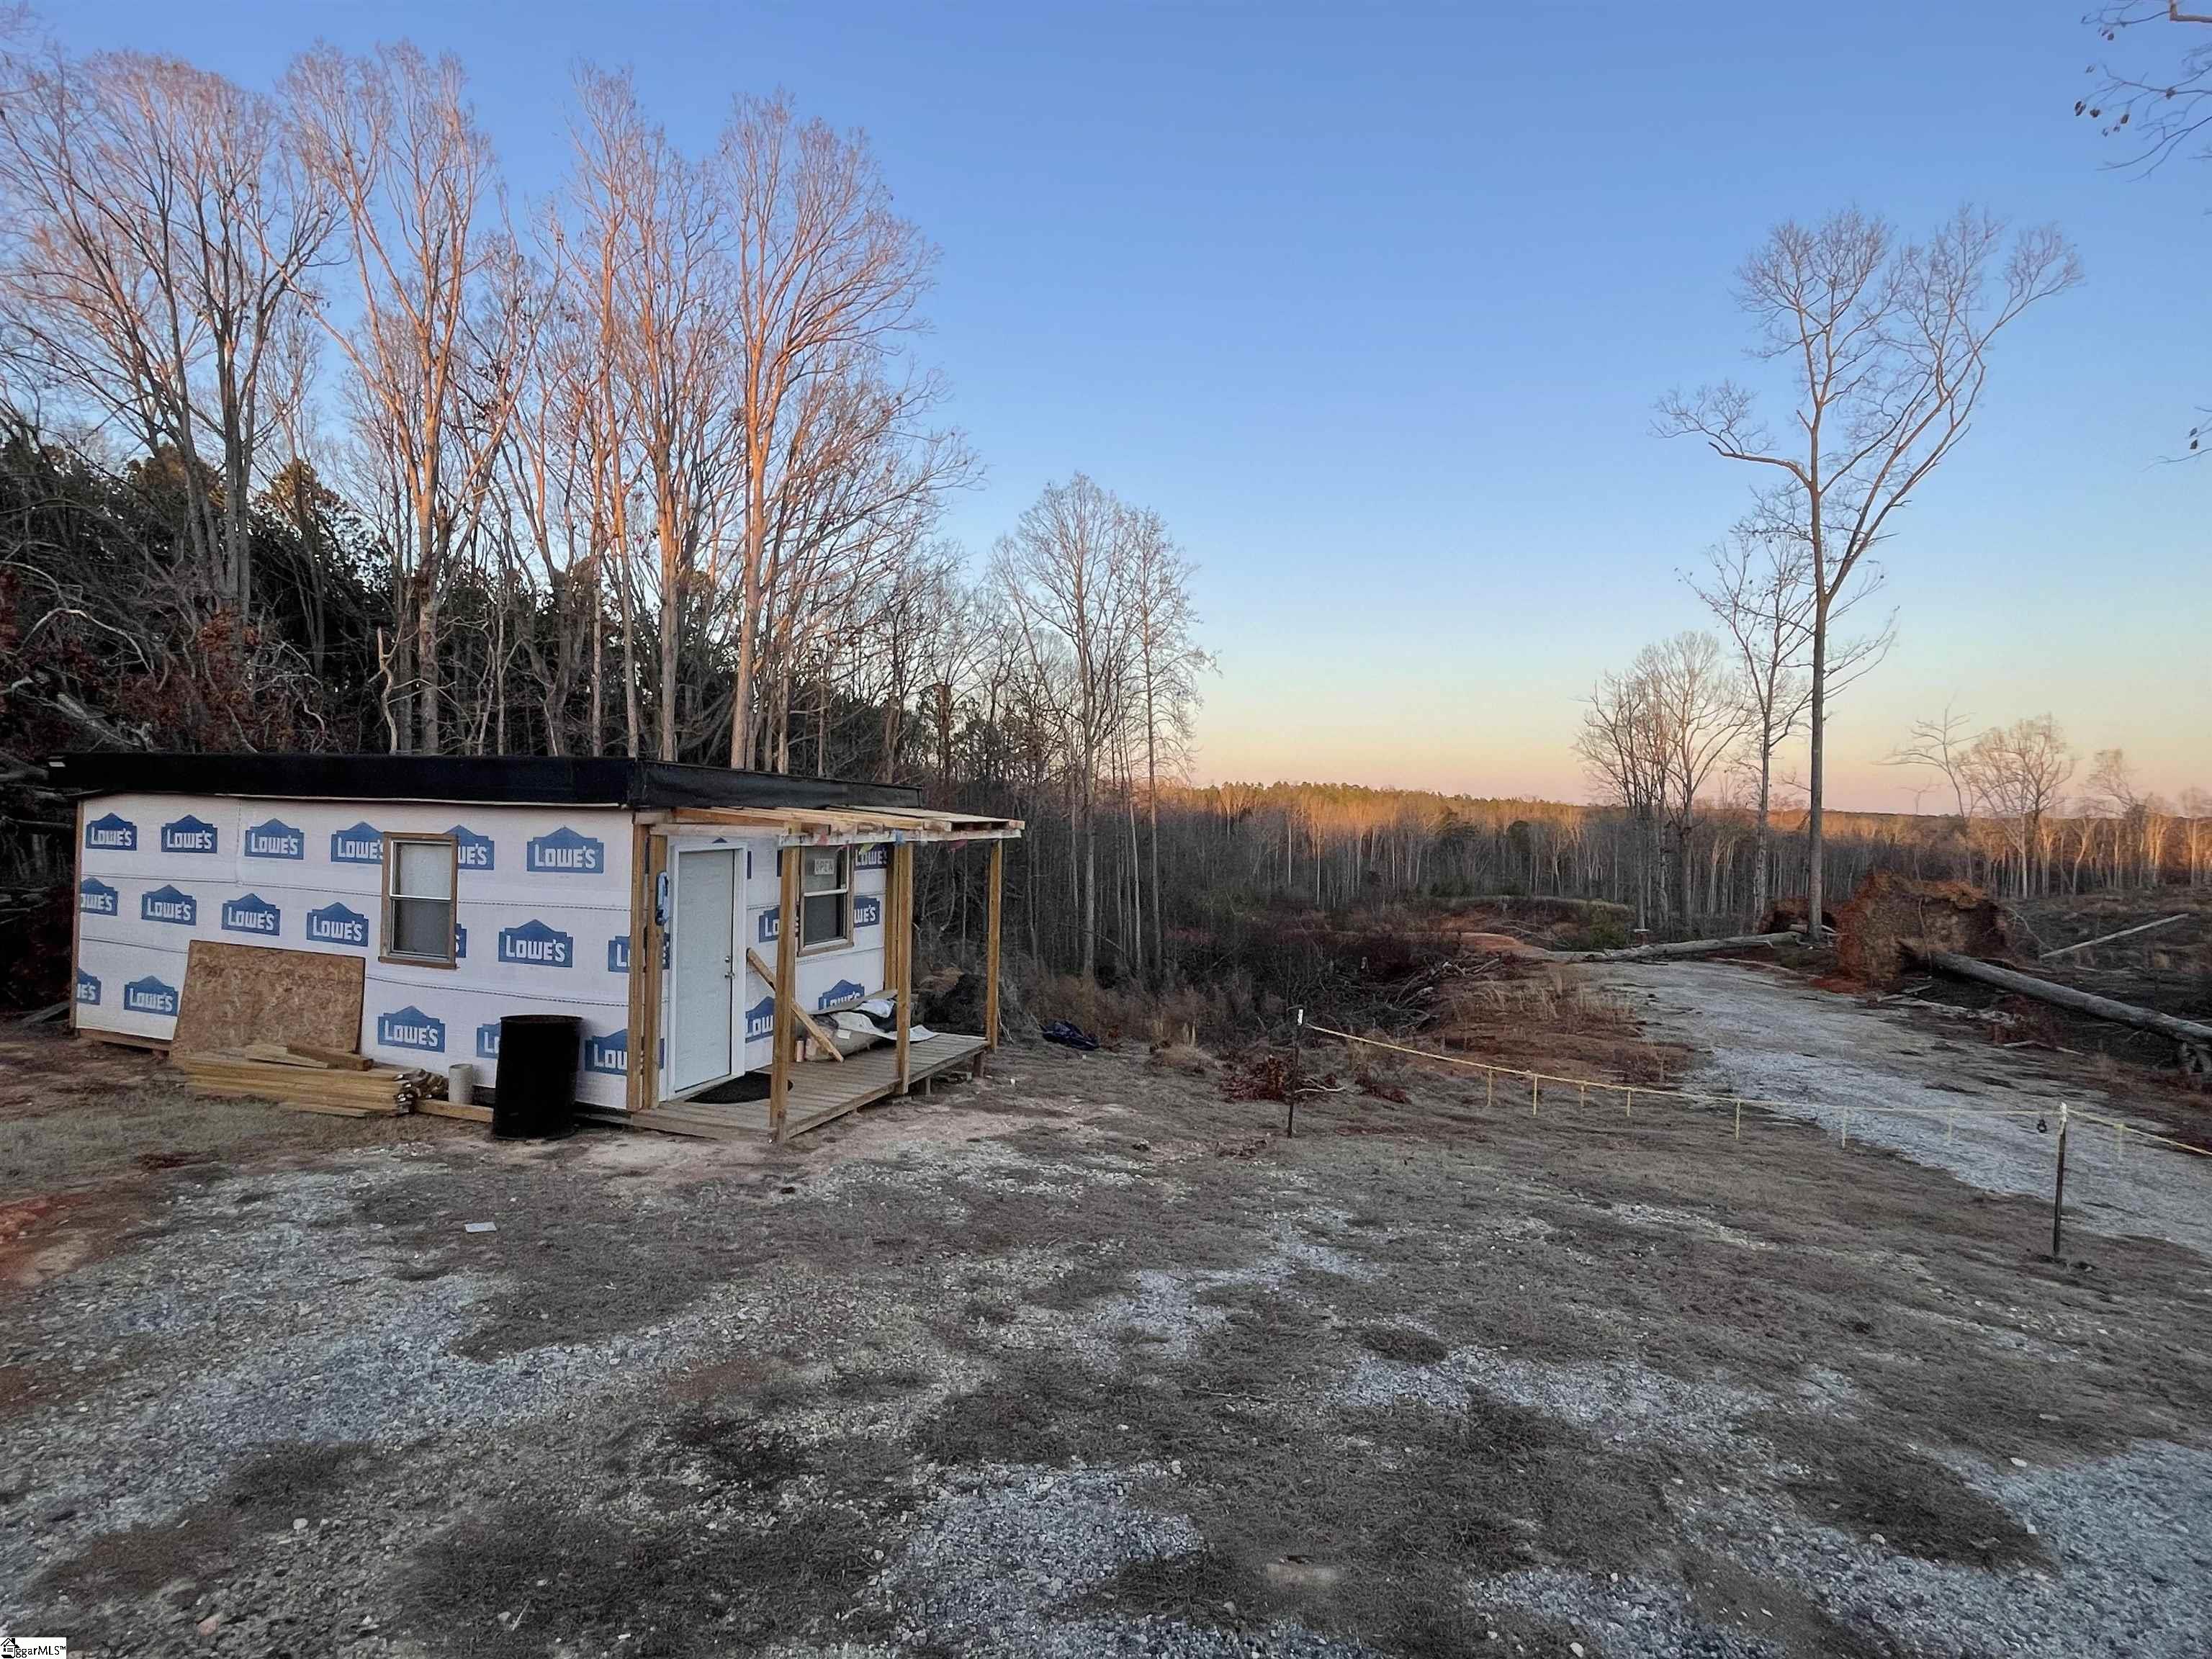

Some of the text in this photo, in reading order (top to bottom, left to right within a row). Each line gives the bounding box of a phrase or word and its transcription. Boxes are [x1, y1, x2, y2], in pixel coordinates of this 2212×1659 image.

[91, 827, 132, 847] LOWE'S
[166, 829, 212, 850] LOWE'S
[251, 833, 298, 855] LOWE'S
[535, 844, 595, 868] LOWE'S
[81, 893, 112, 912] OWE'S
[146, 897, 192, 921] LOWE'S
[854, 904, 876, 923] WE'S
[228, 906, 274, 931] LOWE'S
[313, 916, 362, 941] LOWE'S
[505, 935, 565, 963] LOWE'S
[129, 988, 173, 1012] LOWE'S
[385, 1020, 439, 1047] LOWE'S
